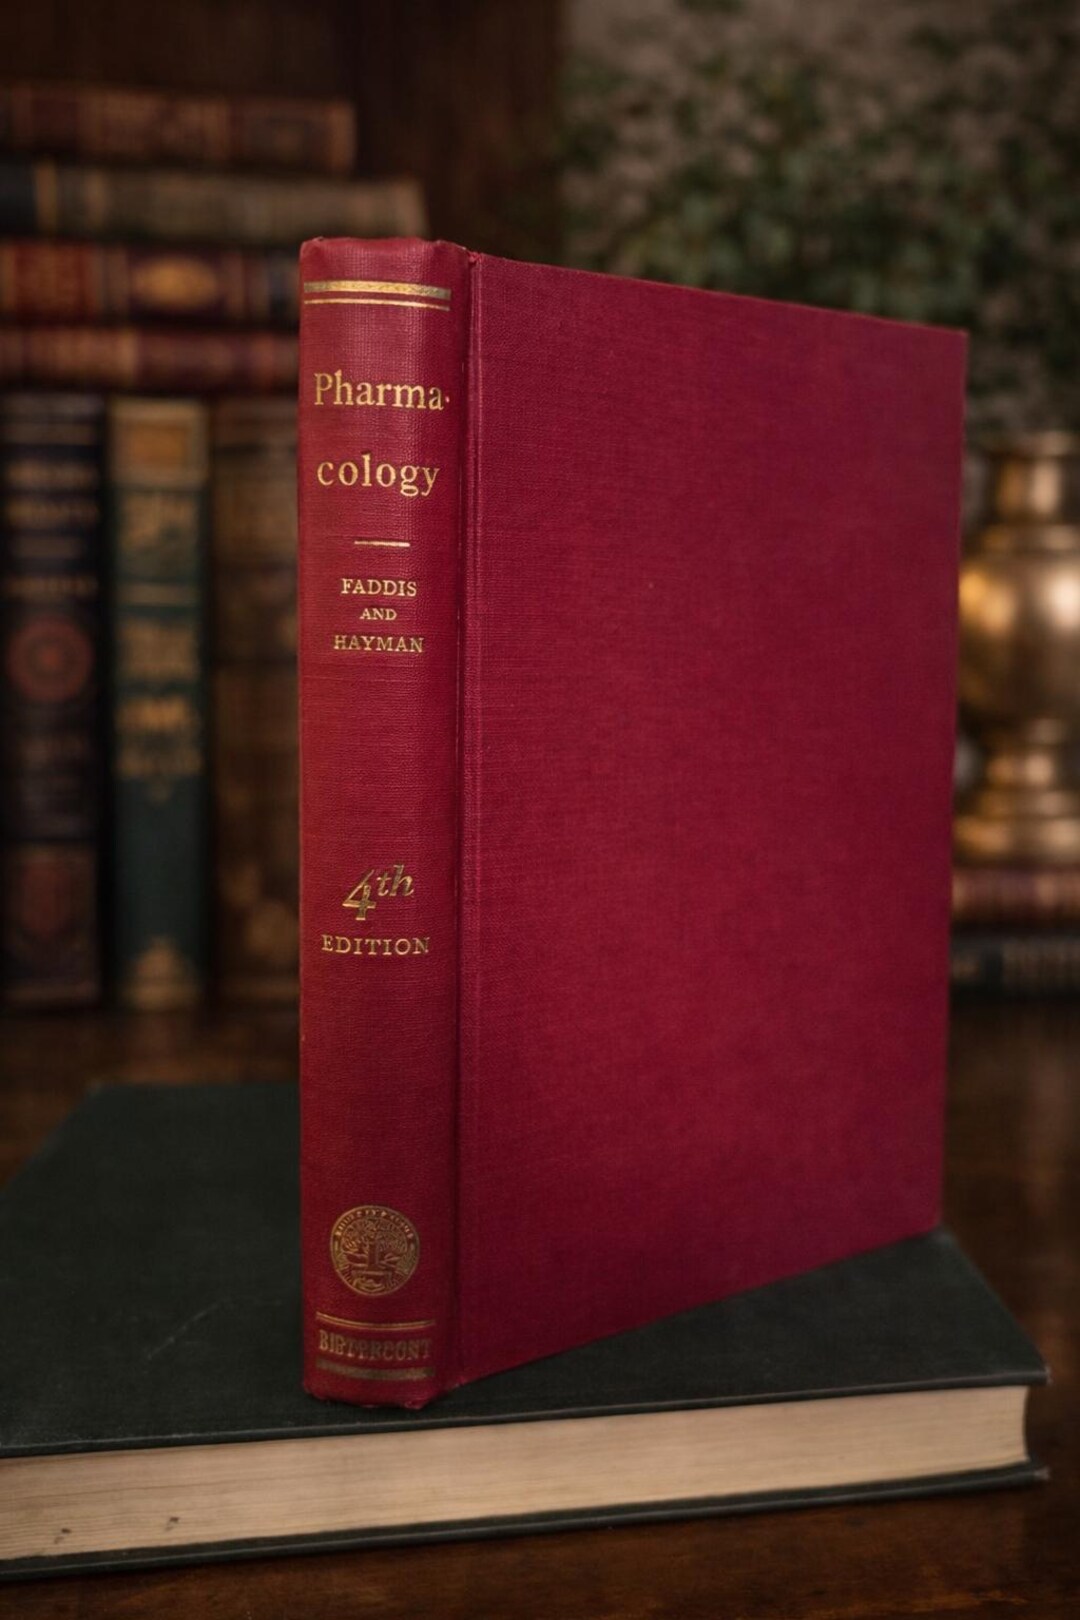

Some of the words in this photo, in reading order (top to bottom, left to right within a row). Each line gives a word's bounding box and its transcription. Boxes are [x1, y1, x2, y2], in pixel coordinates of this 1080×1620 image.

[317, 453, 440, 496] cology
[341, 578, 417, 596] FADDIS
[360, 608, 397, 620] AND
[333, 635, 424, 652] HAYMAN
[342, 864, 415, 921] 4th
[321, 934, 430, 955] EDITION
